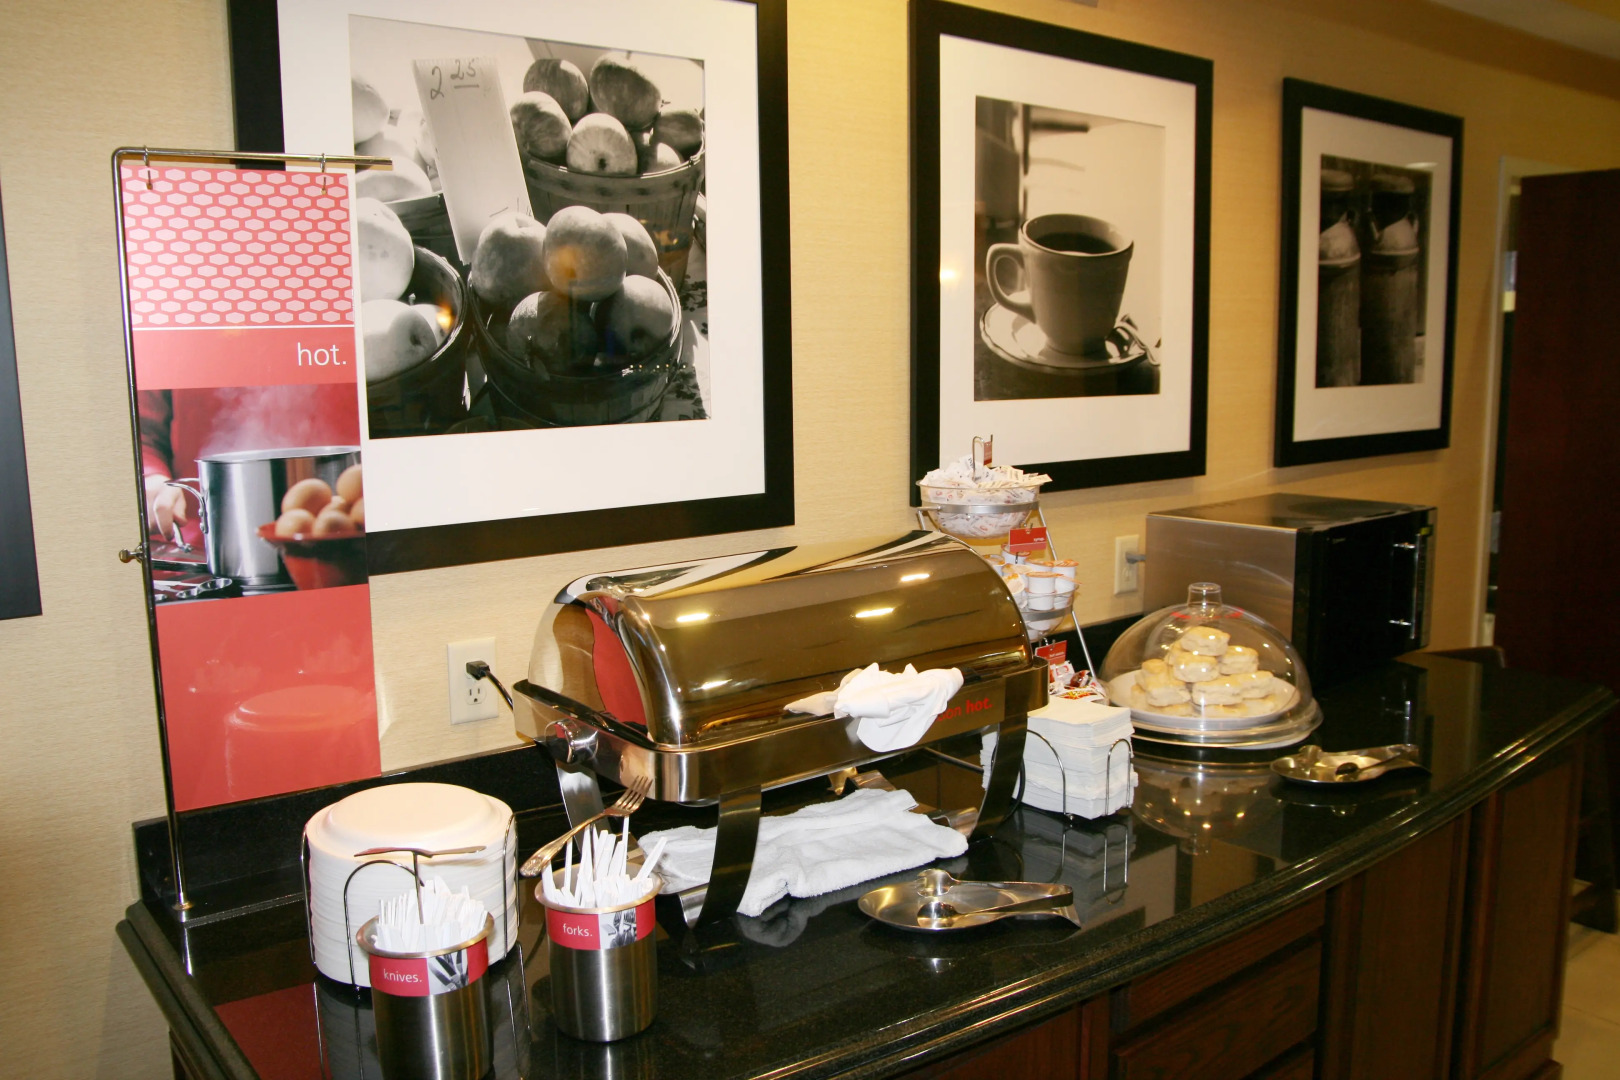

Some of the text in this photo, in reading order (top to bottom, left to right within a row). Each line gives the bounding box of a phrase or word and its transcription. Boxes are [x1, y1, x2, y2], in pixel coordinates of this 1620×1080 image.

[297, 341, 347, 367] hot.
[965, 697, 994, 715] hot.
[562, 922, 593, 938] forks.
[383, 967, 423, 984] knives.
